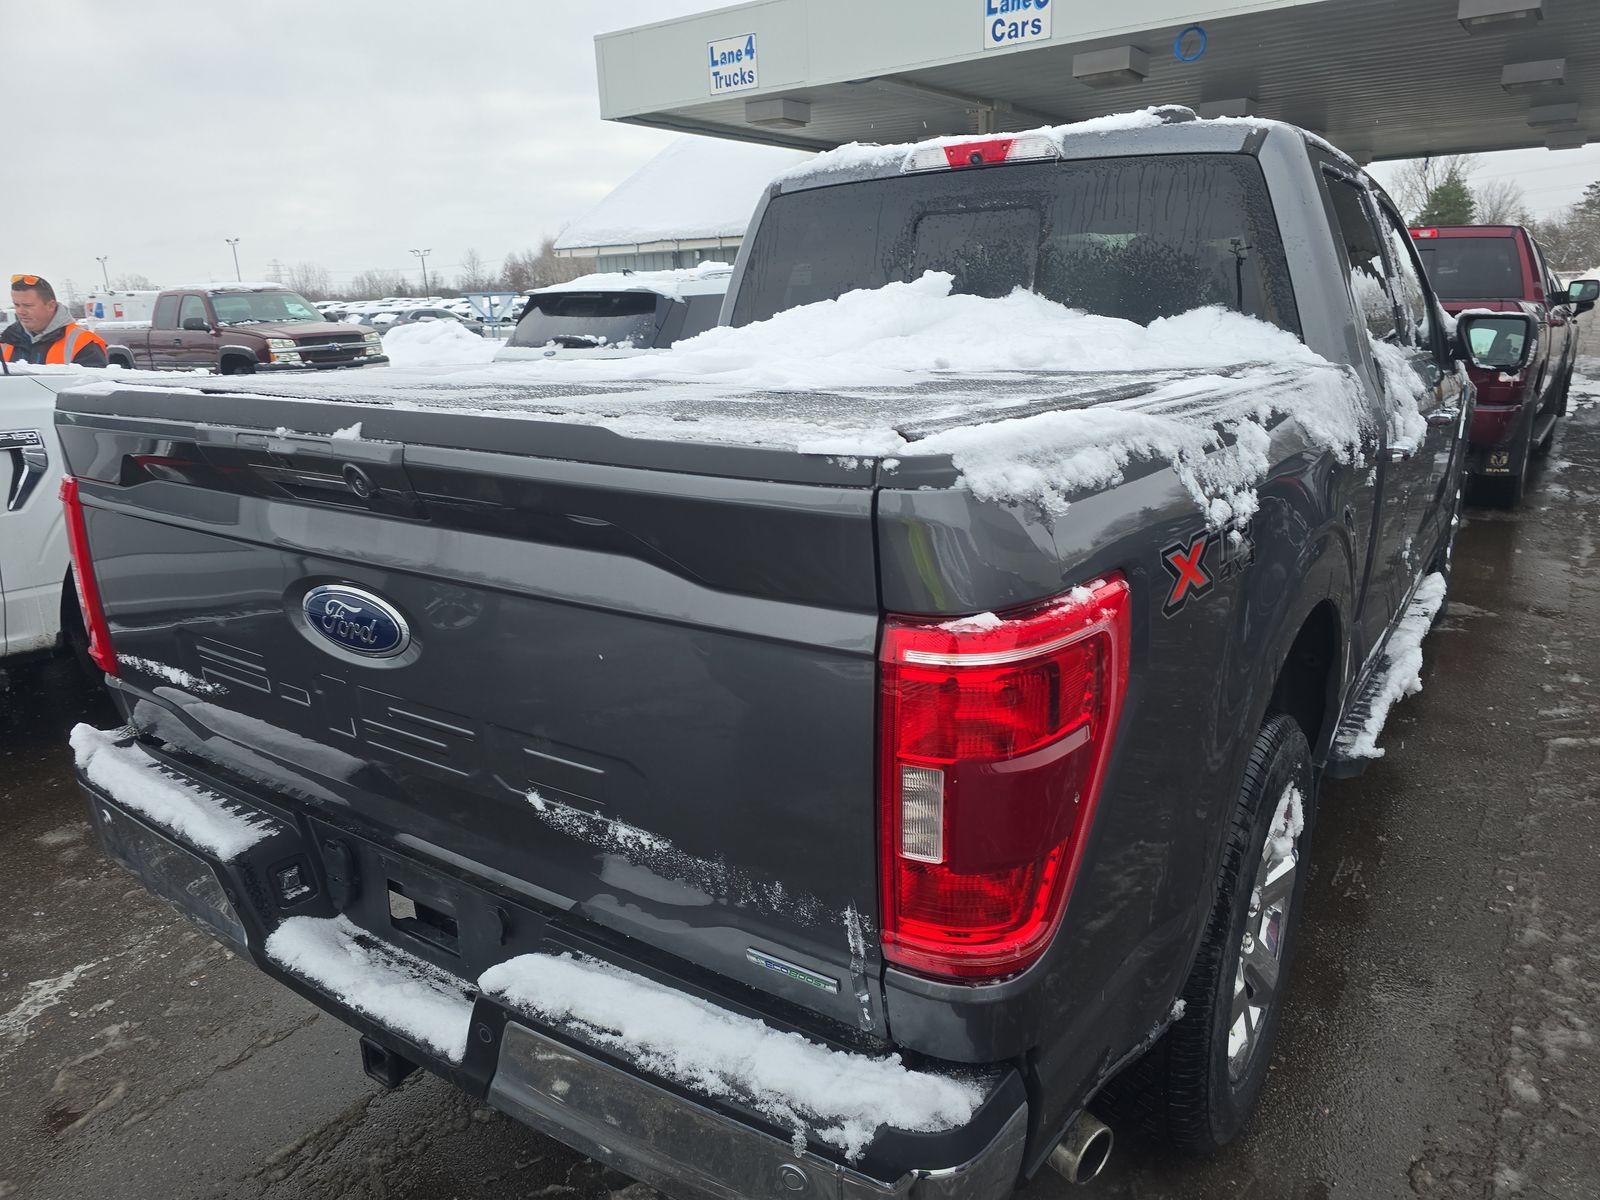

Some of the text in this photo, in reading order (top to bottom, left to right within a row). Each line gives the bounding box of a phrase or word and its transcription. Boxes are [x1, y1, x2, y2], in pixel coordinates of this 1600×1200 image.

[991, 18, 1042, 42] Cars
[712, 67, 755, 89] Trucks
[321, 599, 378, 644] Ford
